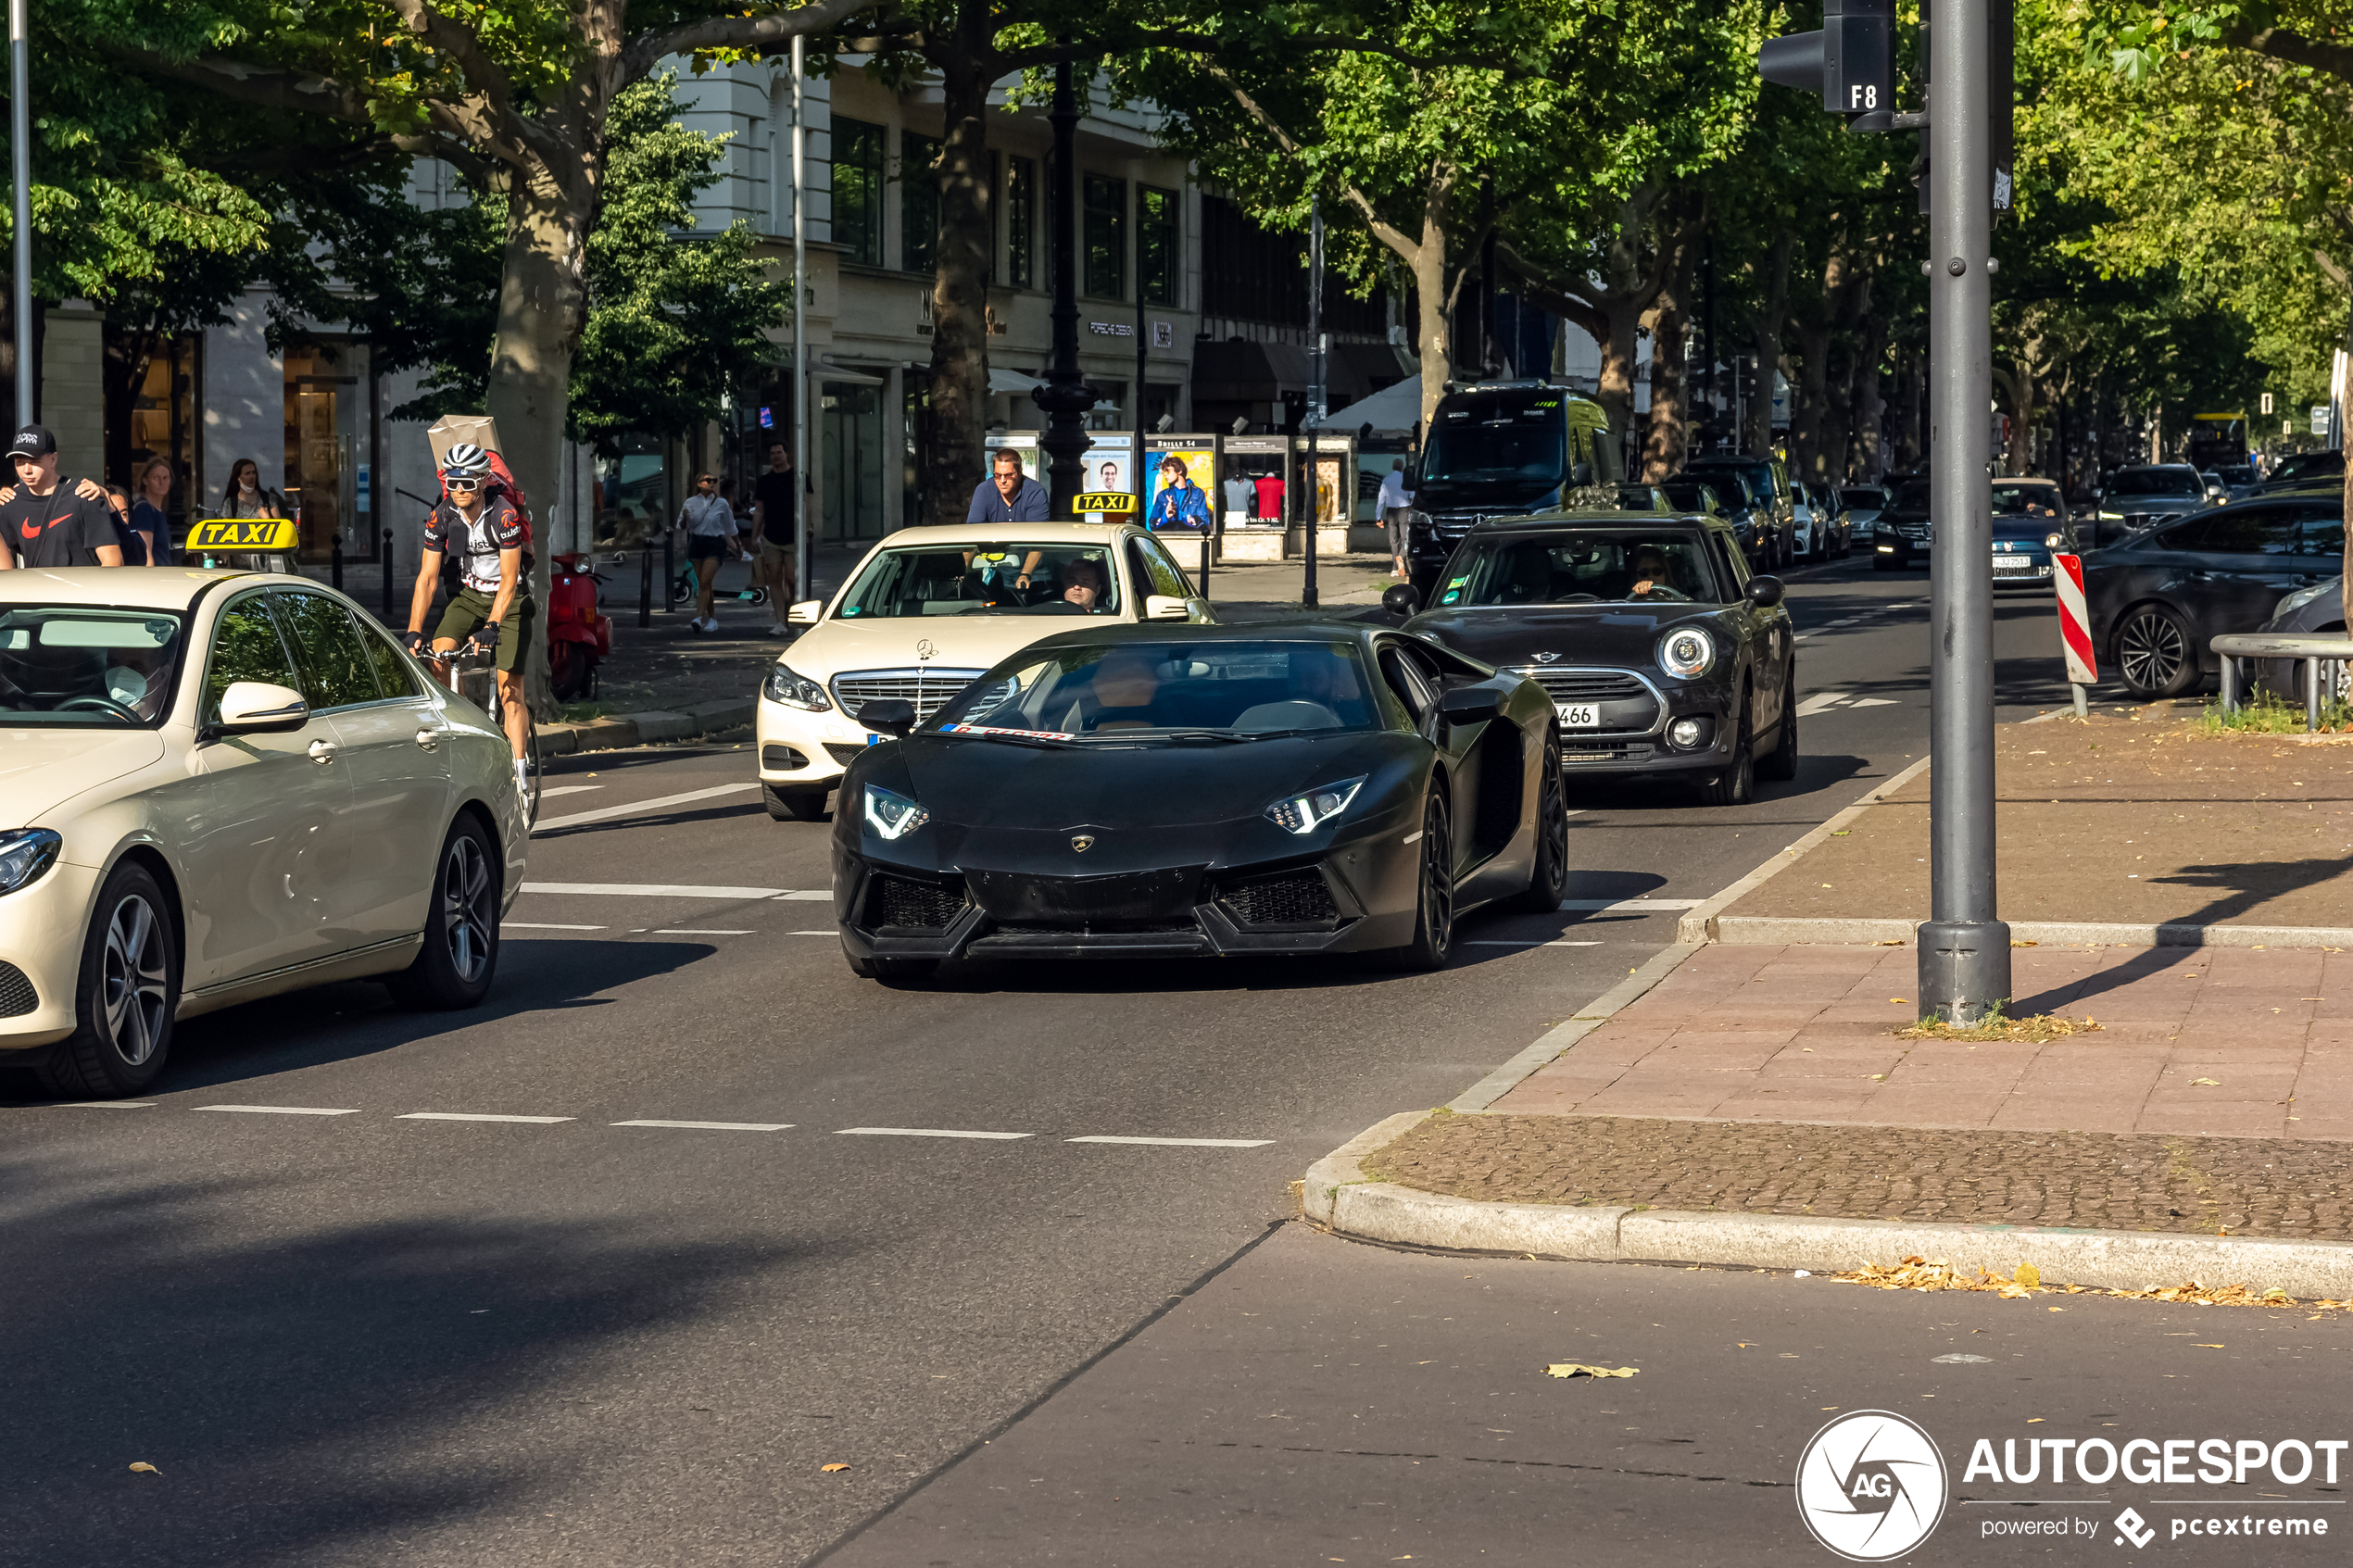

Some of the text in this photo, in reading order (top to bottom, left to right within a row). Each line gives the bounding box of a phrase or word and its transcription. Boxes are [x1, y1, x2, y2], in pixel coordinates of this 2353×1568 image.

[1851, 84, 1877, 109] F8
[1089, 321, 1135, 336] PORSCHE DESIGN
[1083, 495, 1125, 508] TAXI
[206, 523, 276, 543] TAXI
